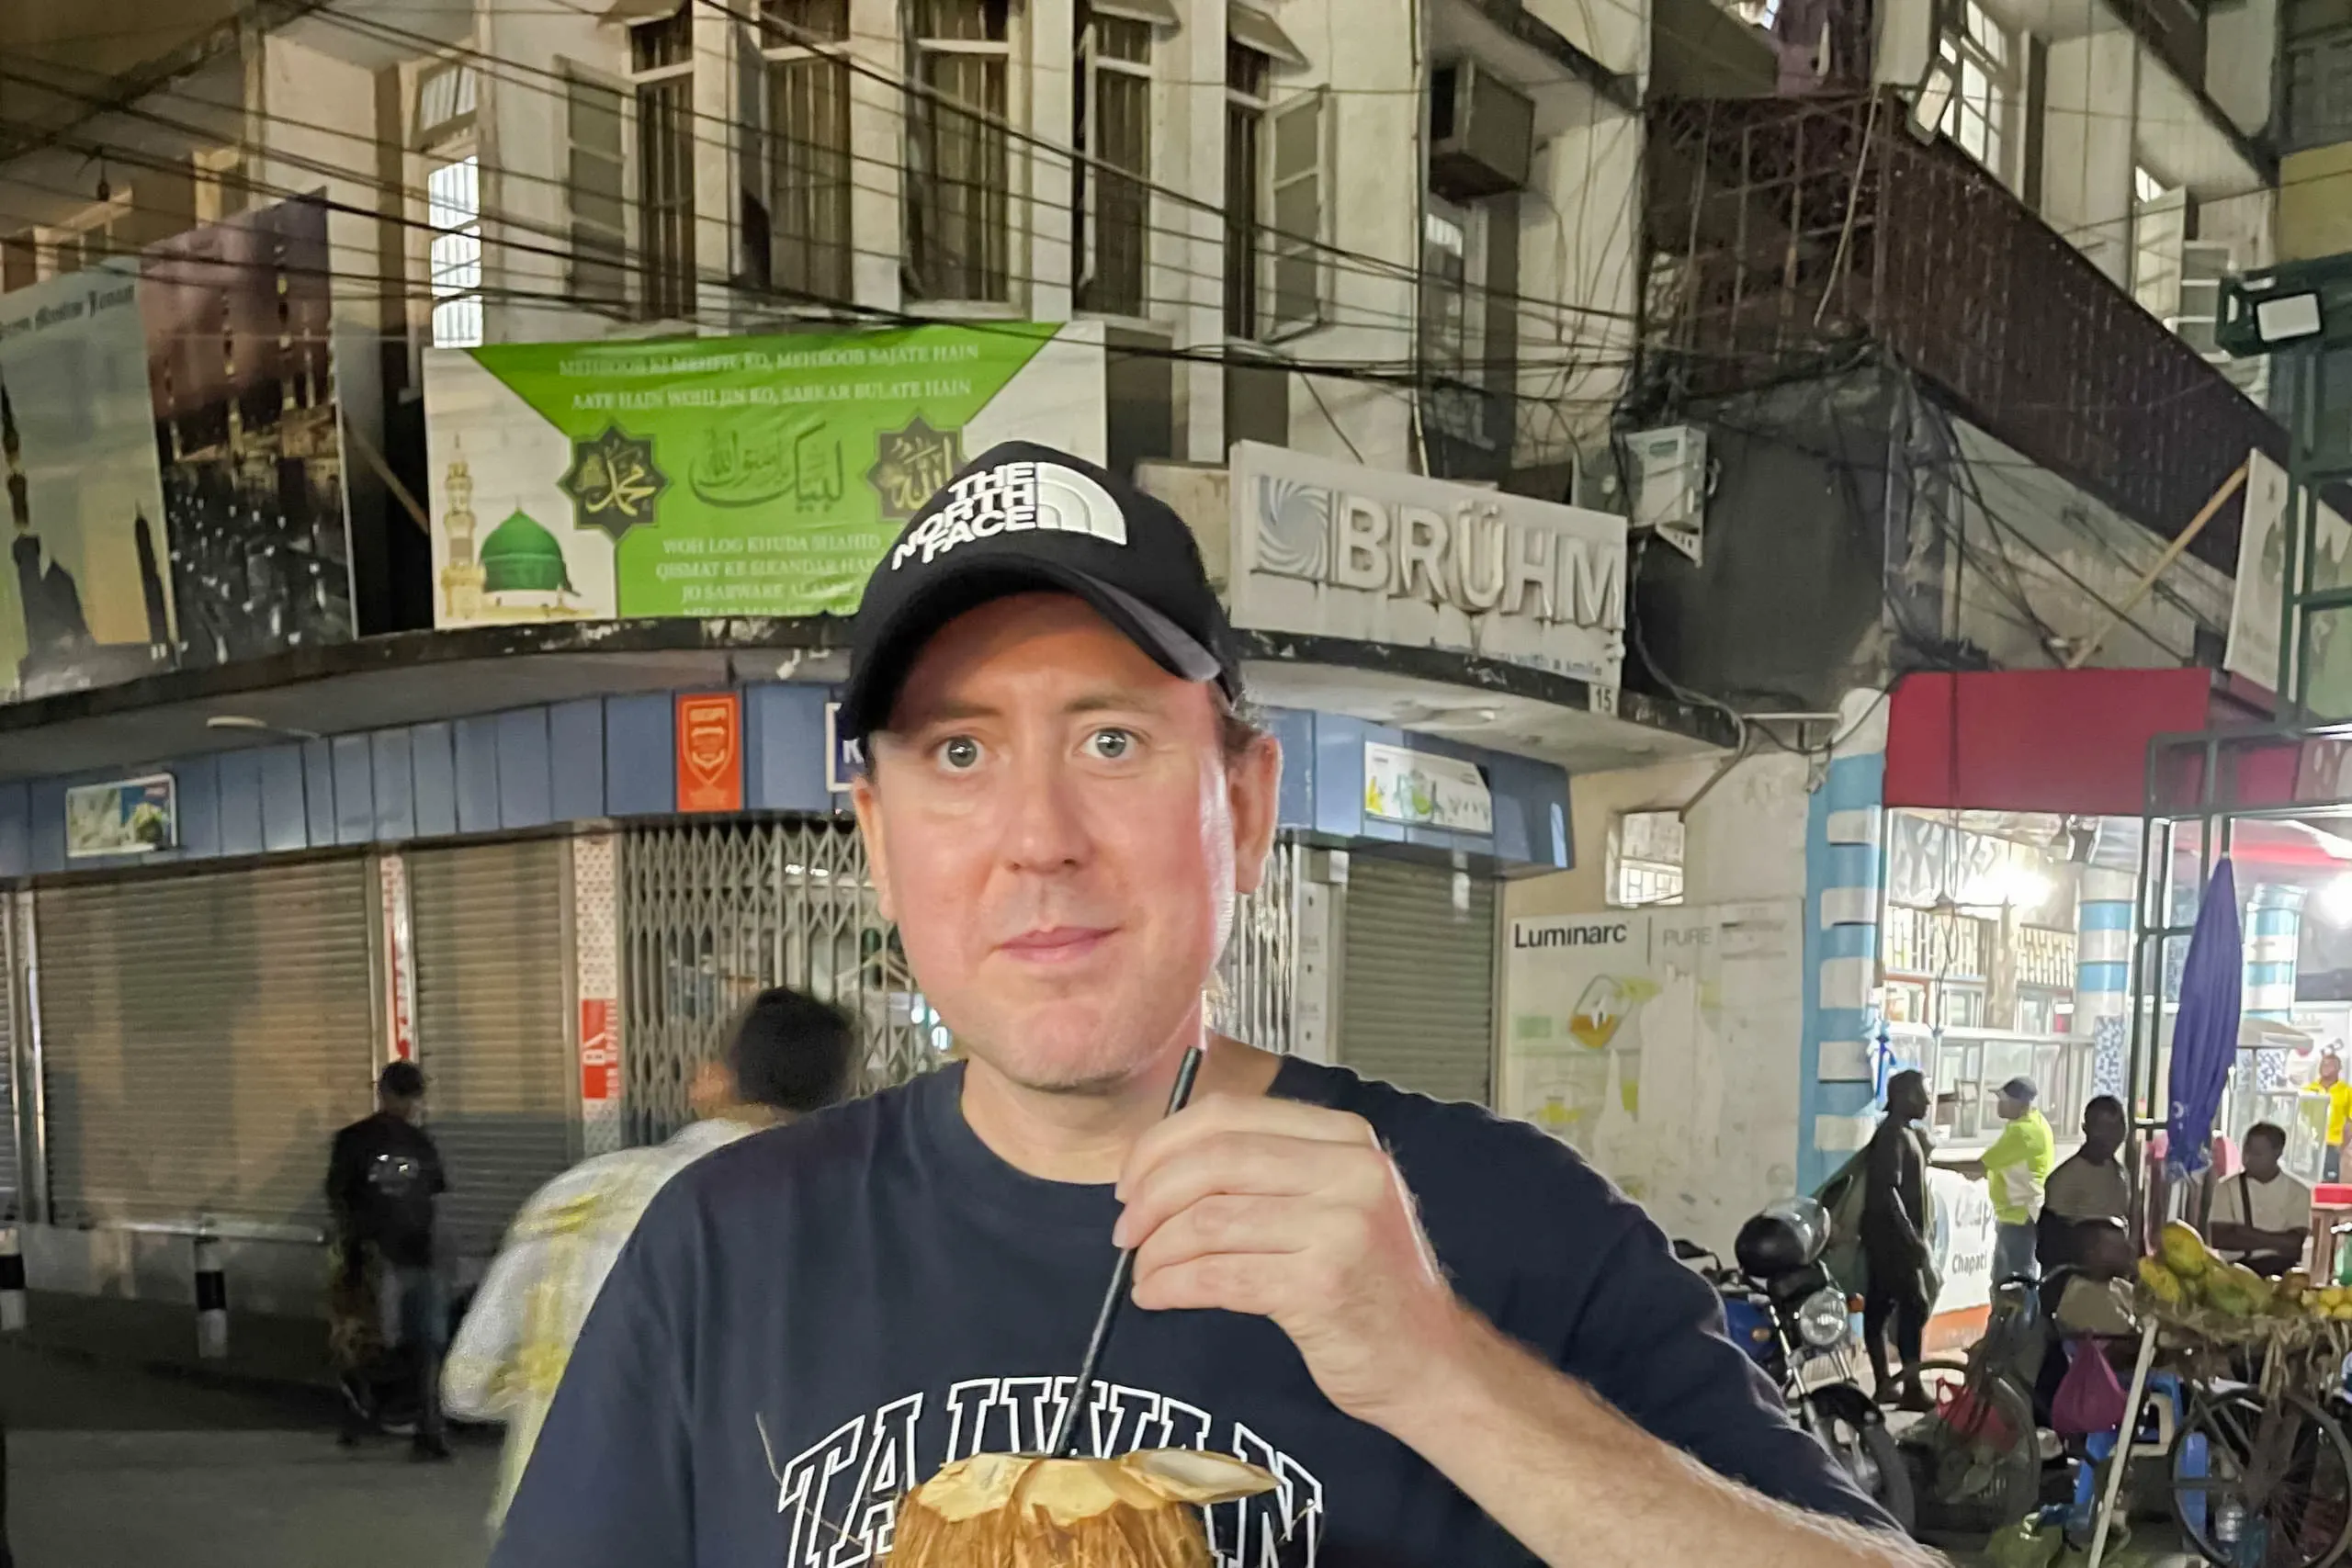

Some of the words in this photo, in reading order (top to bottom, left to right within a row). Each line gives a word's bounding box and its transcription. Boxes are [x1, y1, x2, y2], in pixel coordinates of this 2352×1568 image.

[777, 347, 865, 368] MEHBOOB
[868, 345, 929, 367] SAJATE
[933, 344, 978, 361] HAIN
[619, 390, 662, 409] HAIN
[782, 382, 850, 403] SARKAR
[854, 380, 922, 400] BULATE
[925, 378, 973, 397] HAIN
[947, 461, 1035, 502] THE
[891, 482, 1035, 570] NORTH
[922, 505, 1036, 564] FACE
[662, 537, 704, 555] WOH
[709, 537, 744, 553] LOG
[747, 536, 808, 552] KHUDA
[656, 561, 719, 583] QISMAT
[1330, 492, 1625, 631] BRÜHM
[1596, 689, 1611, 713] 15
[1514, 922, 1627, 948] Luminarc
[1663, 927, 1712, 947] PURE
[1952, 1250, 1988, 1277] Chapati
